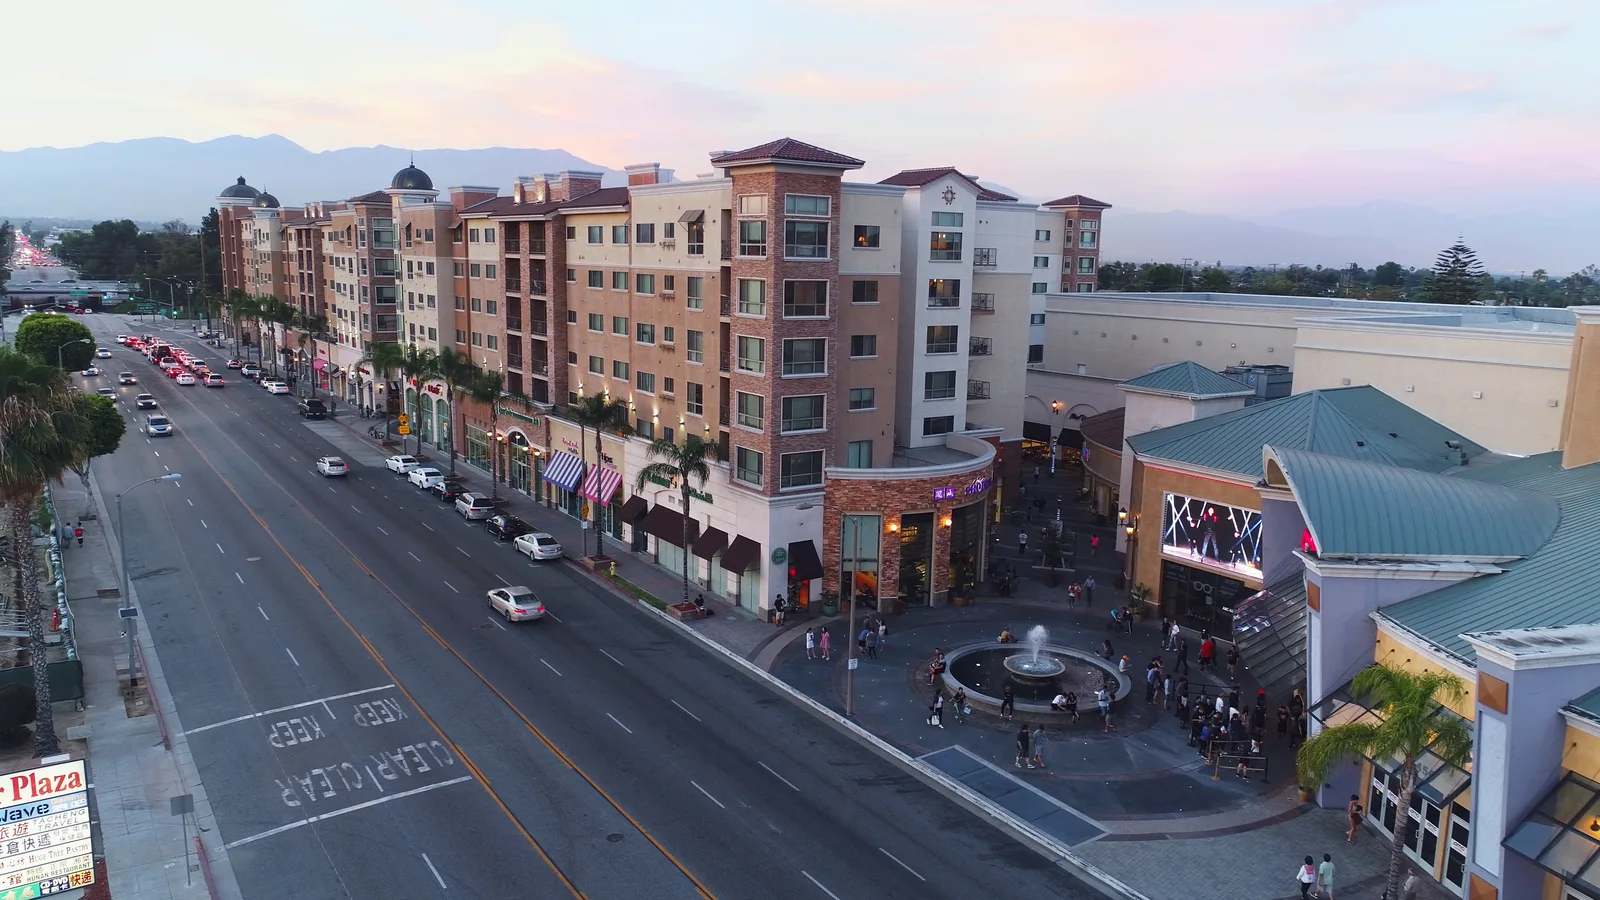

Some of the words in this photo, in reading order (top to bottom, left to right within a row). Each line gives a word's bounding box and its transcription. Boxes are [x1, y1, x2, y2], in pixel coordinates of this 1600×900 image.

[353, 697, 408, 727] KEEP
[269, 715, 326, 748] KEEP
[369, 740, 454, 781] CLEAR
[10, 771, 82, 801] Plaza
[274, 762, 363, 807] CLEAR
[38, 817, 79, 832] TRAVEL
[0, 834, 51, 854] 倉快遞
[51, 862, 91, 877] RESTAURANT
